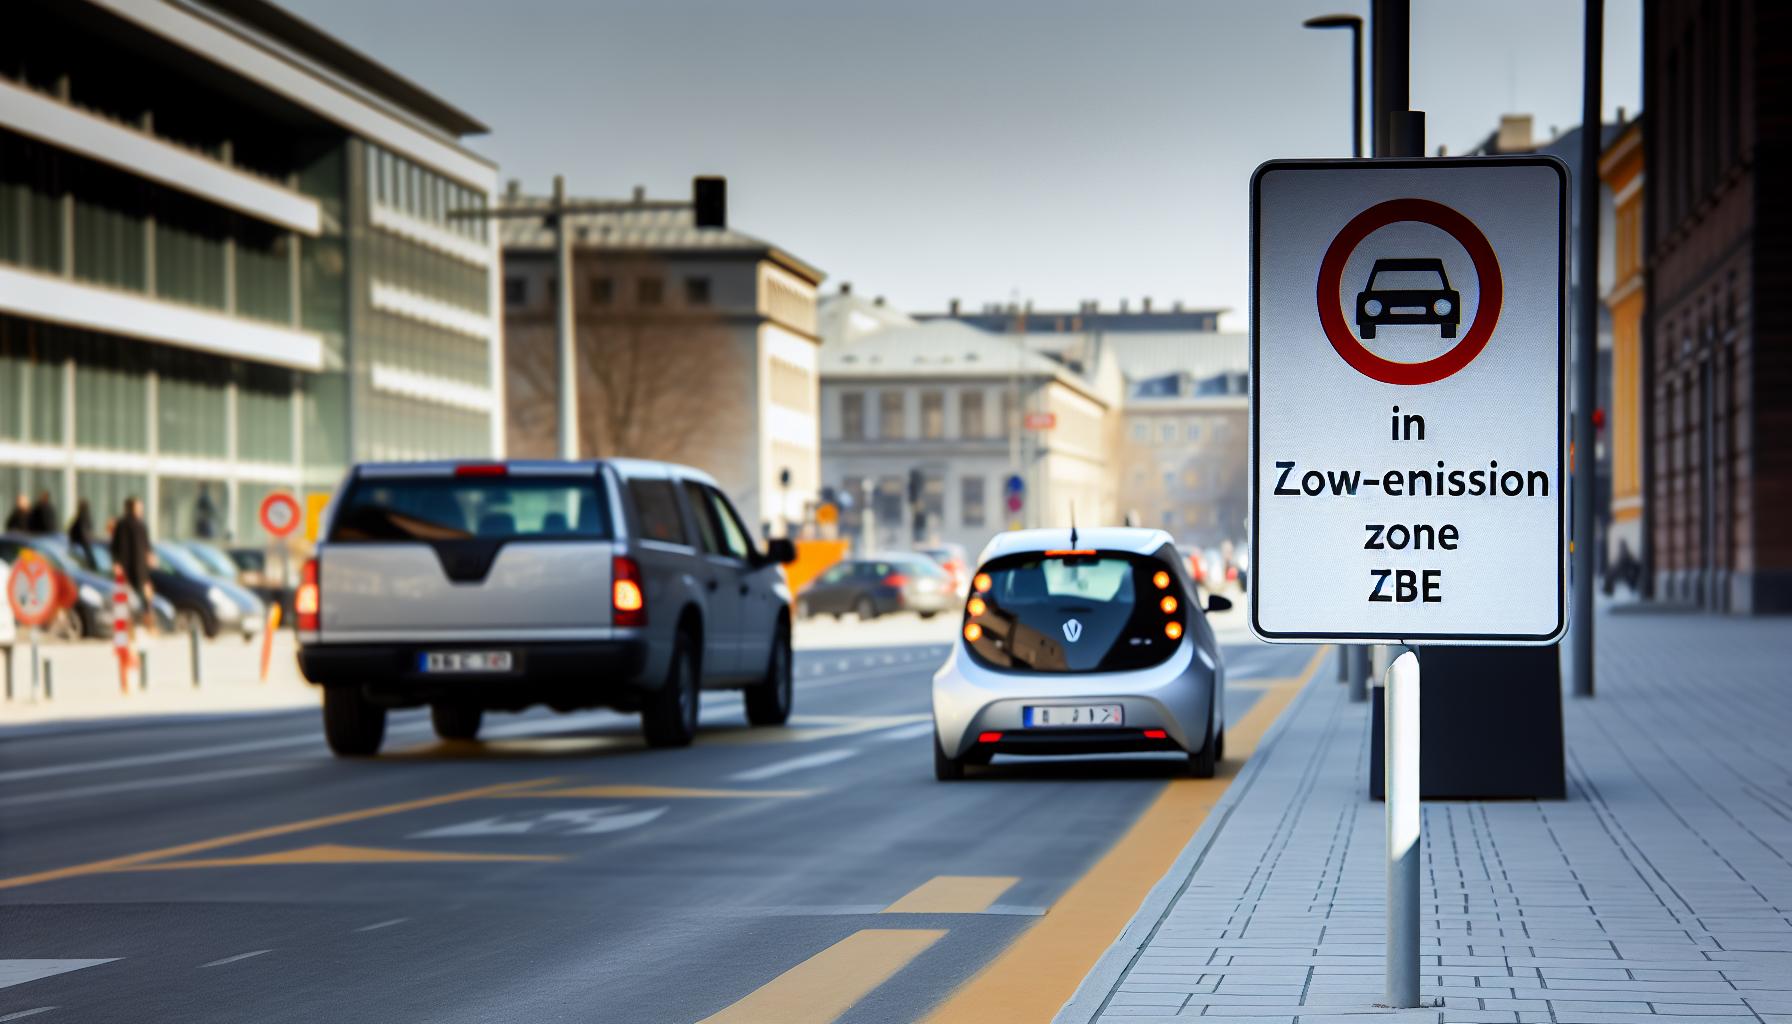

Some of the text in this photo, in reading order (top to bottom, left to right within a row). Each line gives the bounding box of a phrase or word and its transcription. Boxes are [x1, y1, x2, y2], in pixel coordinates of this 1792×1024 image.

[1391, 405, 1425, 441] in
[1273, 460, 1549, 497] Zow-enission
[1363, 523, 1460, 551] zone
[1368, 569, 1442, 603] ZBE
